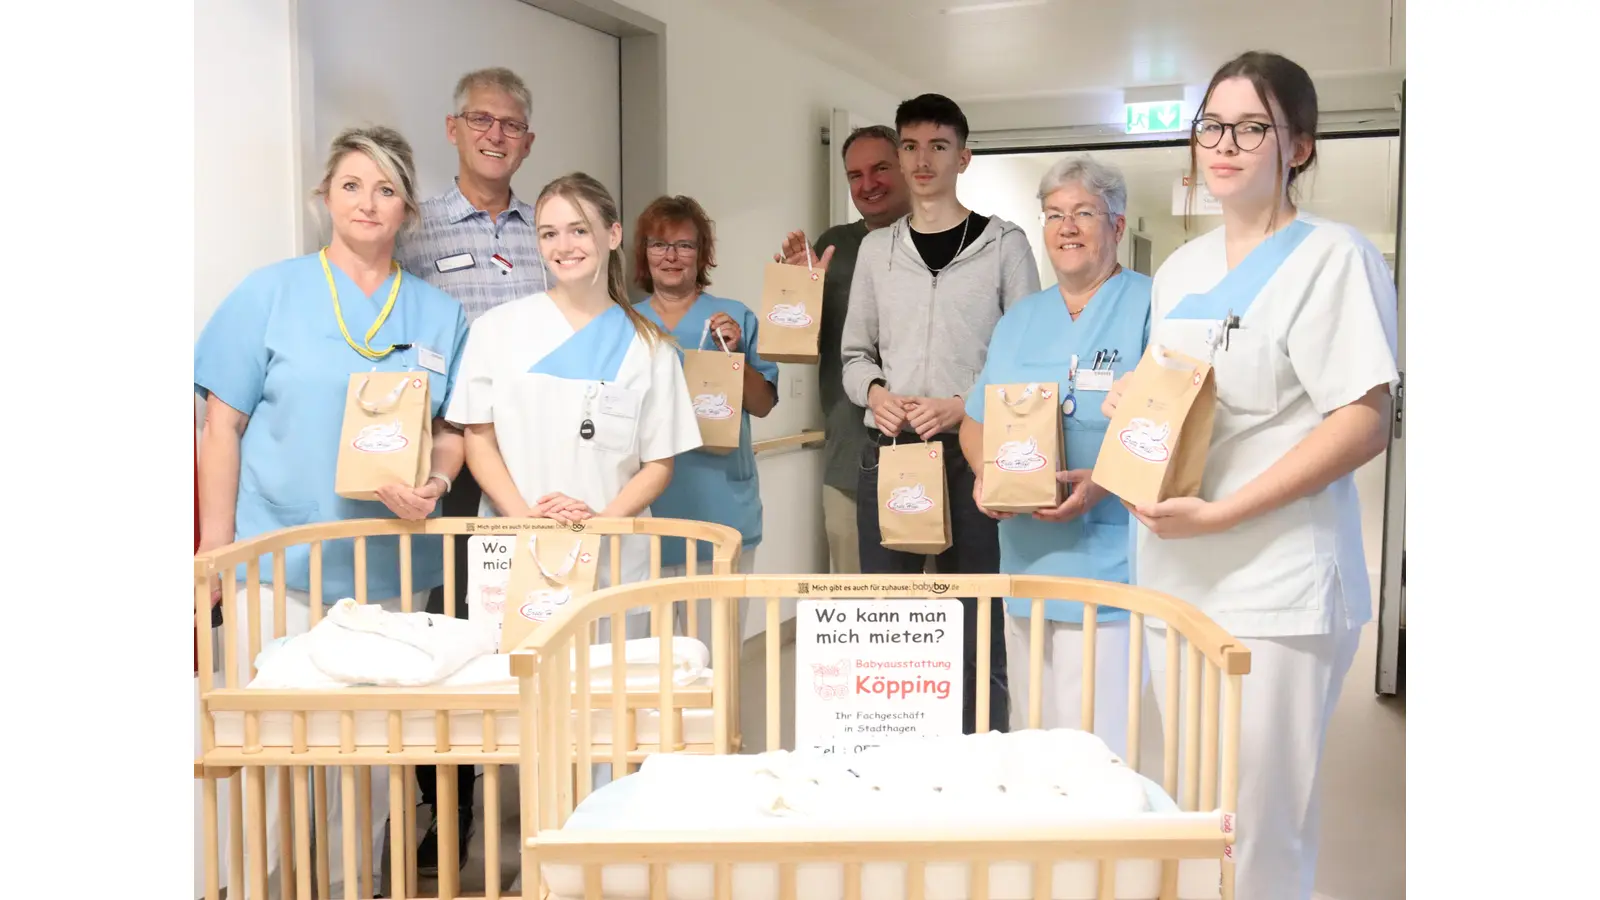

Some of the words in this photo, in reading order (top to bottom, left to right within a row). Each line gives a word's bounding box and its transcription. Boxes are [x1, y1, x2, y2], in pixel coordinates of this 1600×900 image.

[482, 542, 507, 553] Wo
[829, 584, 843, 592] gibt
[815, 608, 847, 623] Wo
[856, 608, 900, 623] kann
[909, 611, 947, 623] man
[816, 629, 860, 643] mich
[869, 629, 945, 643] mieten?
[855, 659, 951, 670] Babyausstattung
[855, 675, 951, 699] Köpping
[835, 711, 852, 720] Ihr
[856, 711, 925, 721] Fachgeschäft
[857, 724, 916, 734] Stadthagen
